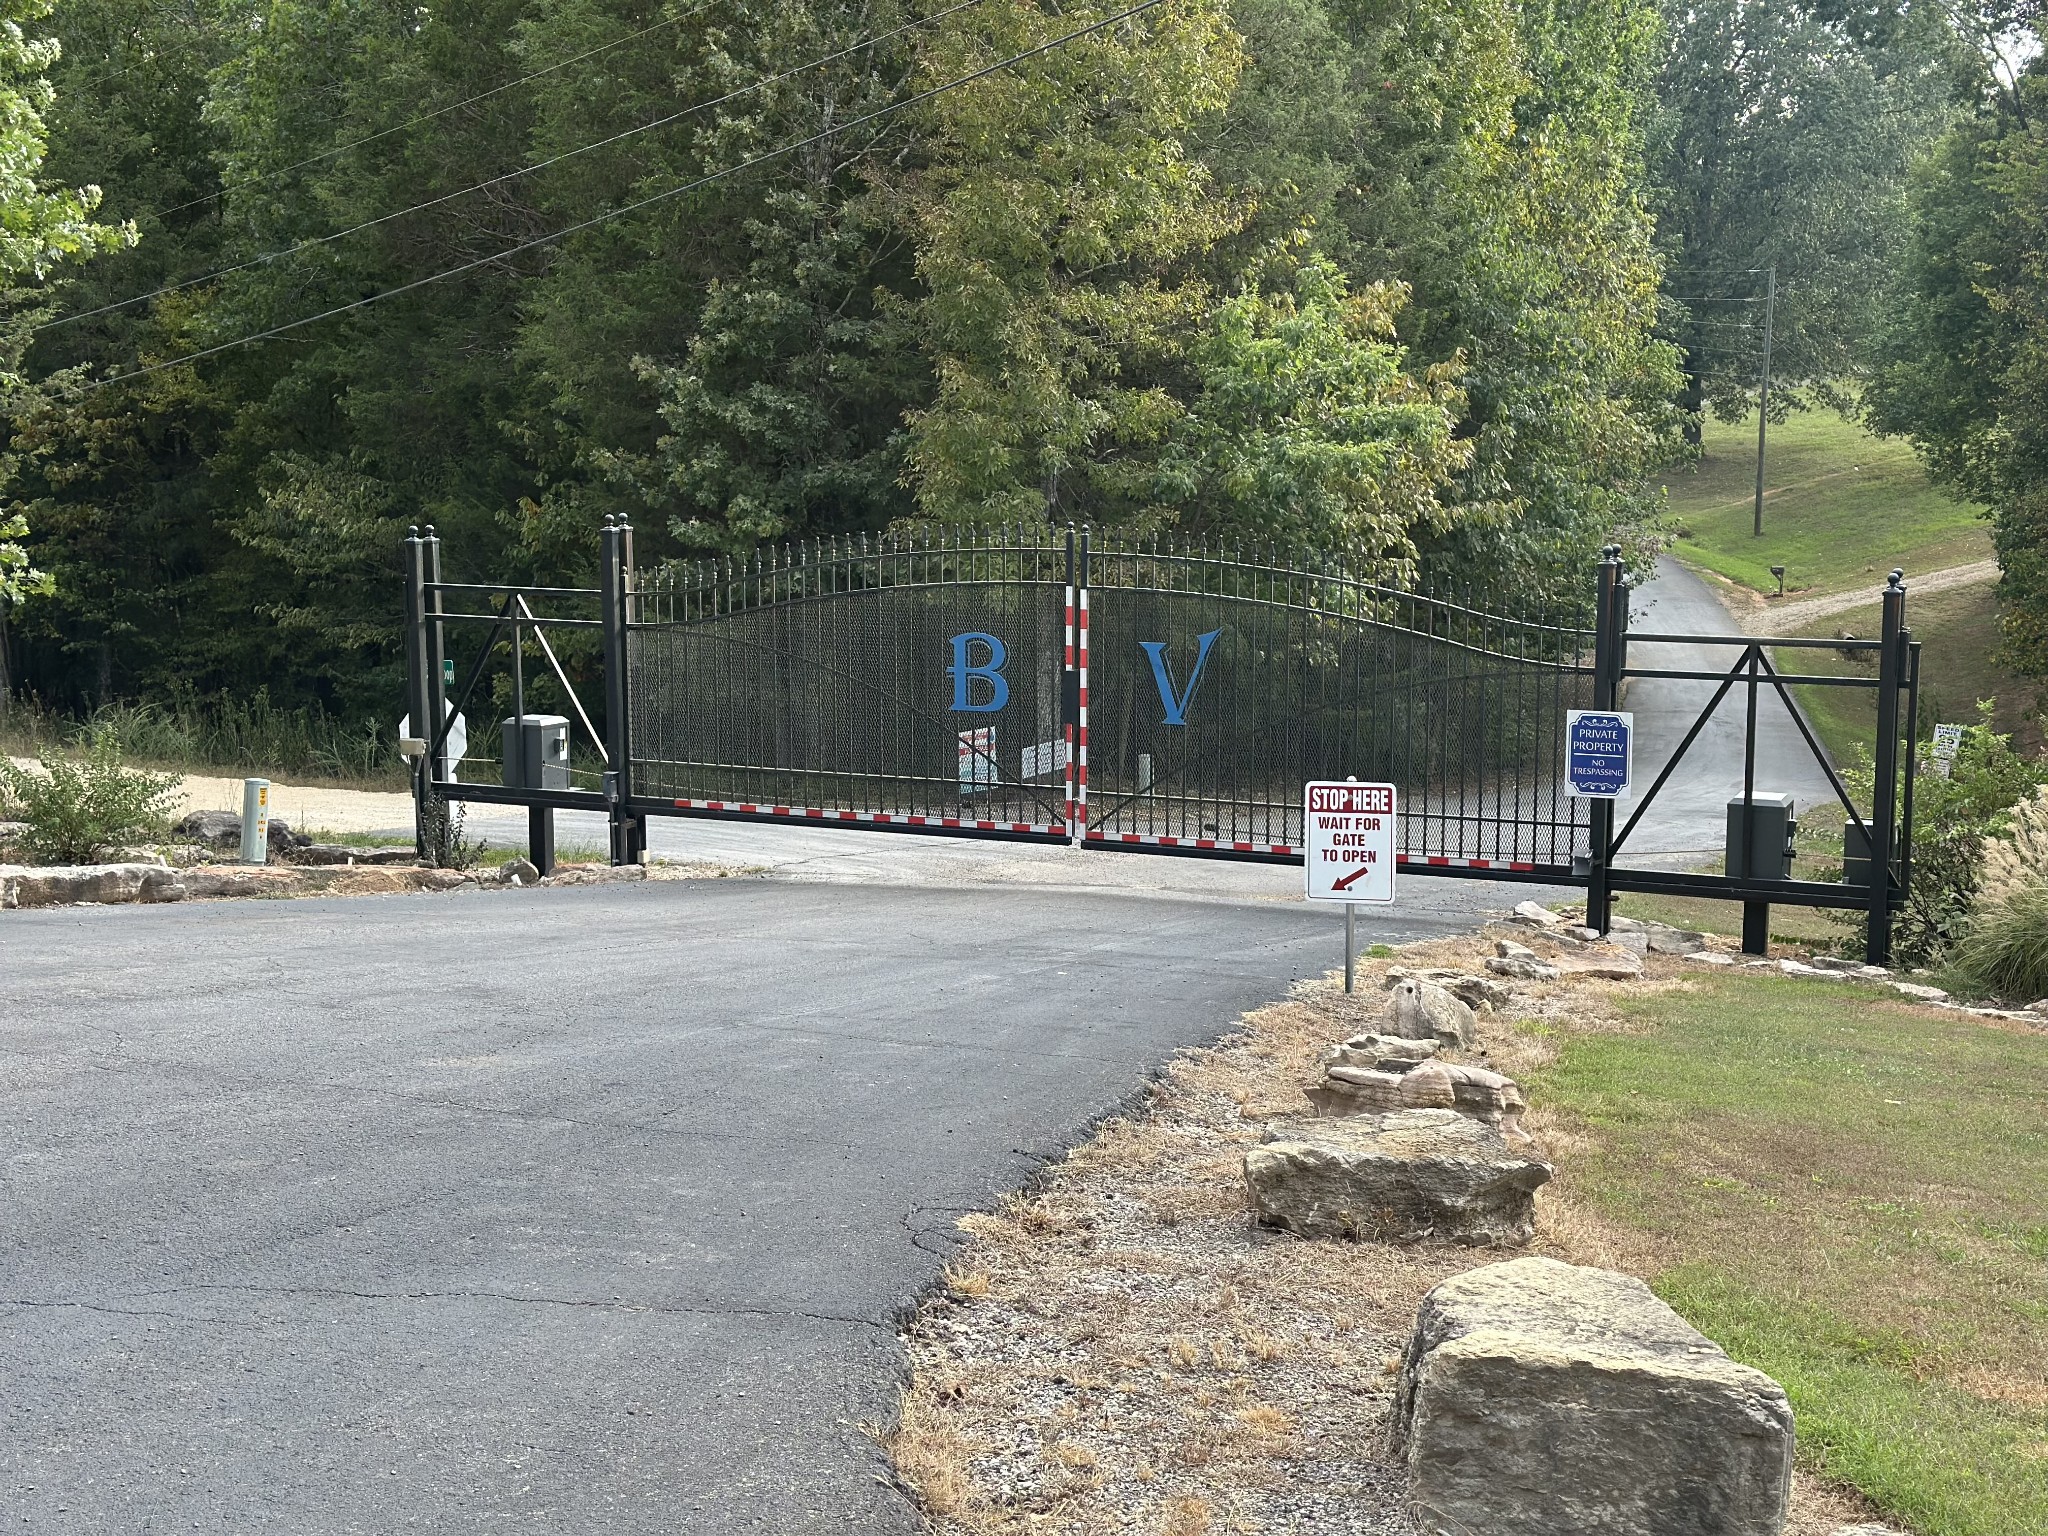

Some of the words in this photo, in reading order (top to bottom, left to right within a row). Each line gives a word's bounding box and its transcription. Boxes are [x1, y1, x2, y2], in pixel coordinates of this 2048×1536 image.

[946, 632, 1010, 712] B
[1138, 627, 1224, 725] V
[1579, 729, 1618, 739] PRIVATE
[1937, 725, 1960, 733] SPEED
[1573, 741, 1624, 752] PROPERTY
[1591, 759, 1605, 767] NO
[1573, 767, 1624, 777] TRESPASSING
[1312, 788, 1348, 810] STOP
[1352, 790, 1389, 811] HERE
[1318, 817, 1351, 830] WAIT
[1355, 818, 1381, 831] FOR
[1333, 833, 1365, 847] GATE
[1322, 849, 1338, 862] TO
[1343, 850, 1377, 863] OPEN
